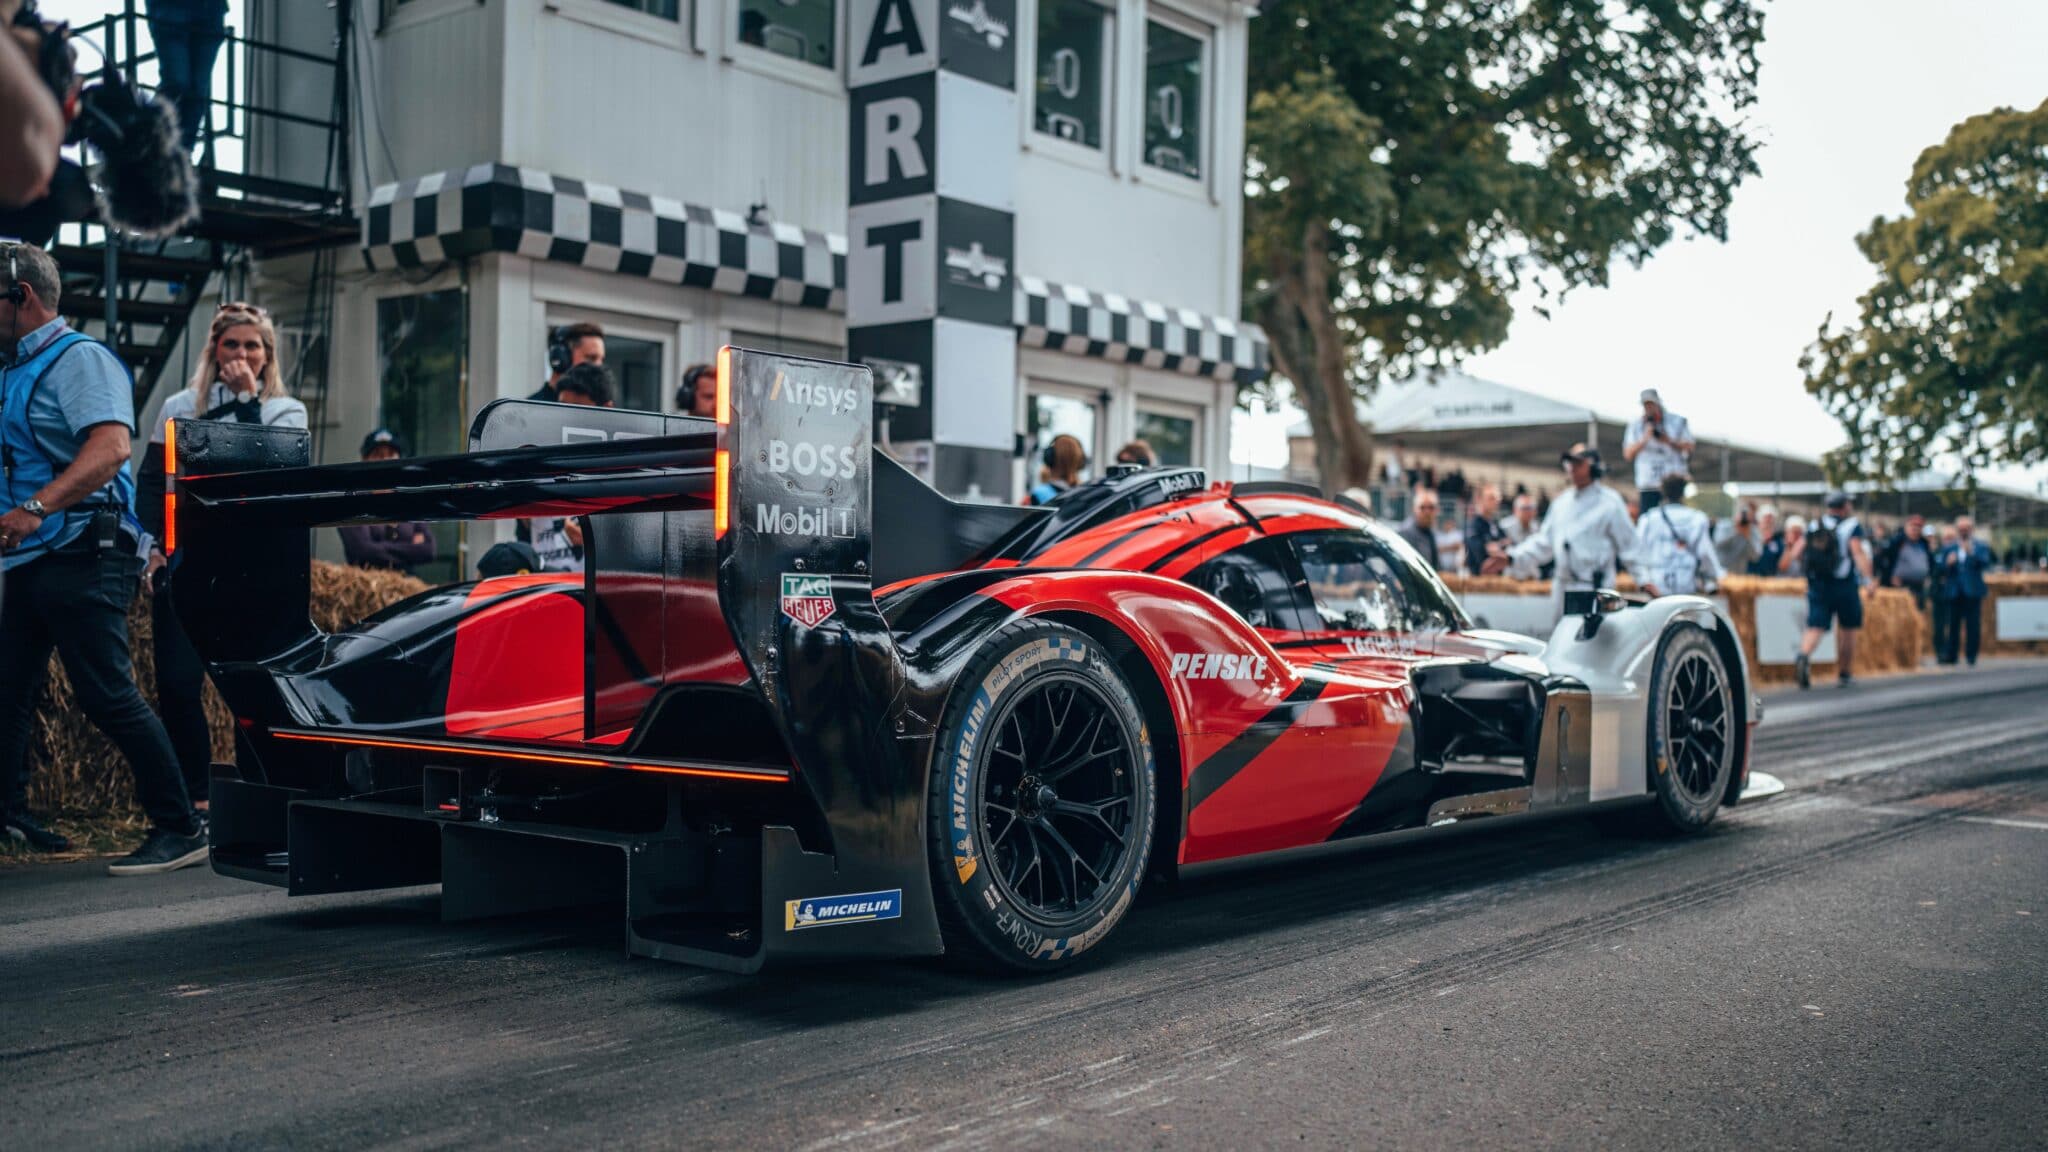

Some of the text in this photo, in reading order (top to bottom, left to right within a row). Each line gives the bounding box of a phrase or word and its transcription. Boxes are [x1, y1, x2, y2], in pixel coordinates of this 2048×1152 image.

[770, 371, 858, 415] Ansys
[768, 439, 857, 480] BOSS
[1158, 474, 1192, 495] Mobil
[756, 503, 828, 537] Mobil
[785, 577, 828, 595] TAG
[784, 599, 833, 625] HEUER
[990, 645, 1042, 689] PILOT SPORT
[1169, 652, 1269, 681] PENSKE
[953, 698, 987, 831] MICHELIN
[817, 899, 893, 918] MICHELIN
